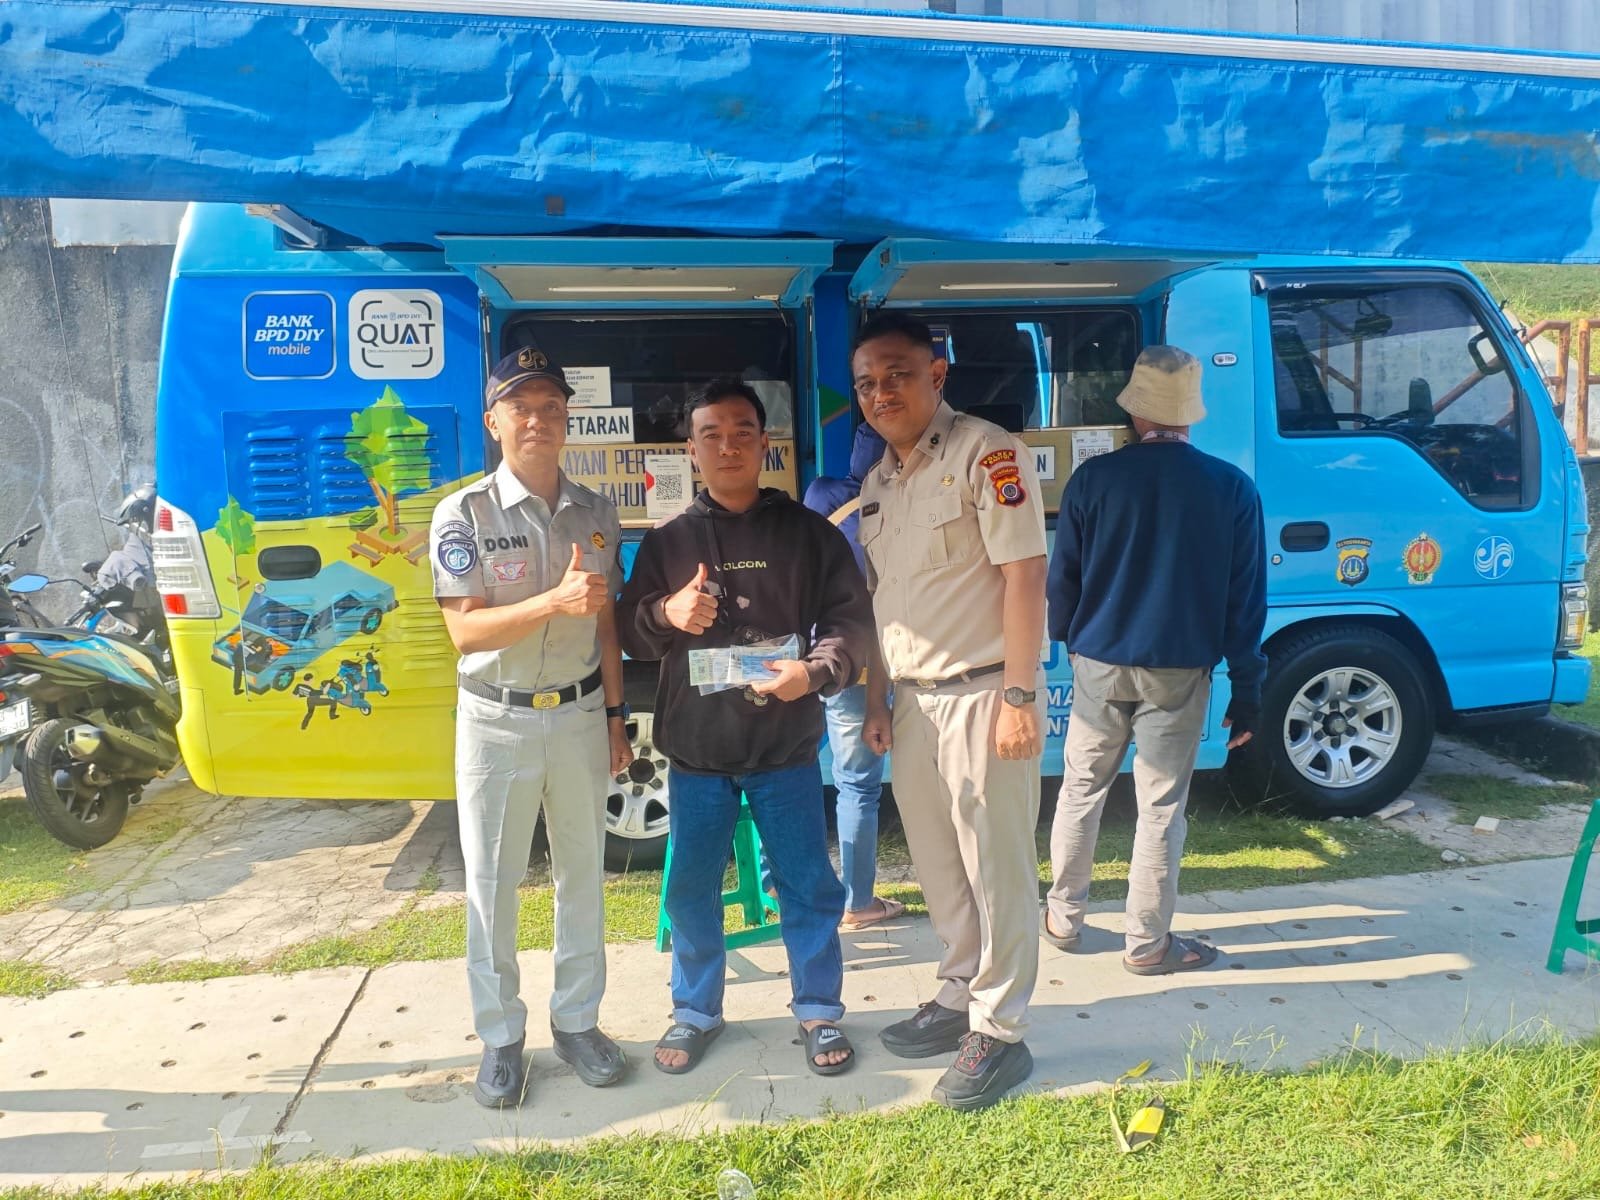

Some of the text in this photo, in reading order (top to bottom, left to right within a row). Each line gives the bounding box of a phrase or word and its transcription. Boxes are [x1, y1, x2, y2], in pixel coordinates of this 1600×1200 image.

[265, 315, 314, 328] BANK
[254, 329, 325, 342] BPD DIY
[357, 323, 436, 348] QUAT
[268, 342, 311, 355] mobile
[566, 415, 630, 436] FTARAN
[564, 449, 607, 476] AYANI
[484, 535, 529, 553] DONI
[821, 1028, 841, 1038] NIKE
